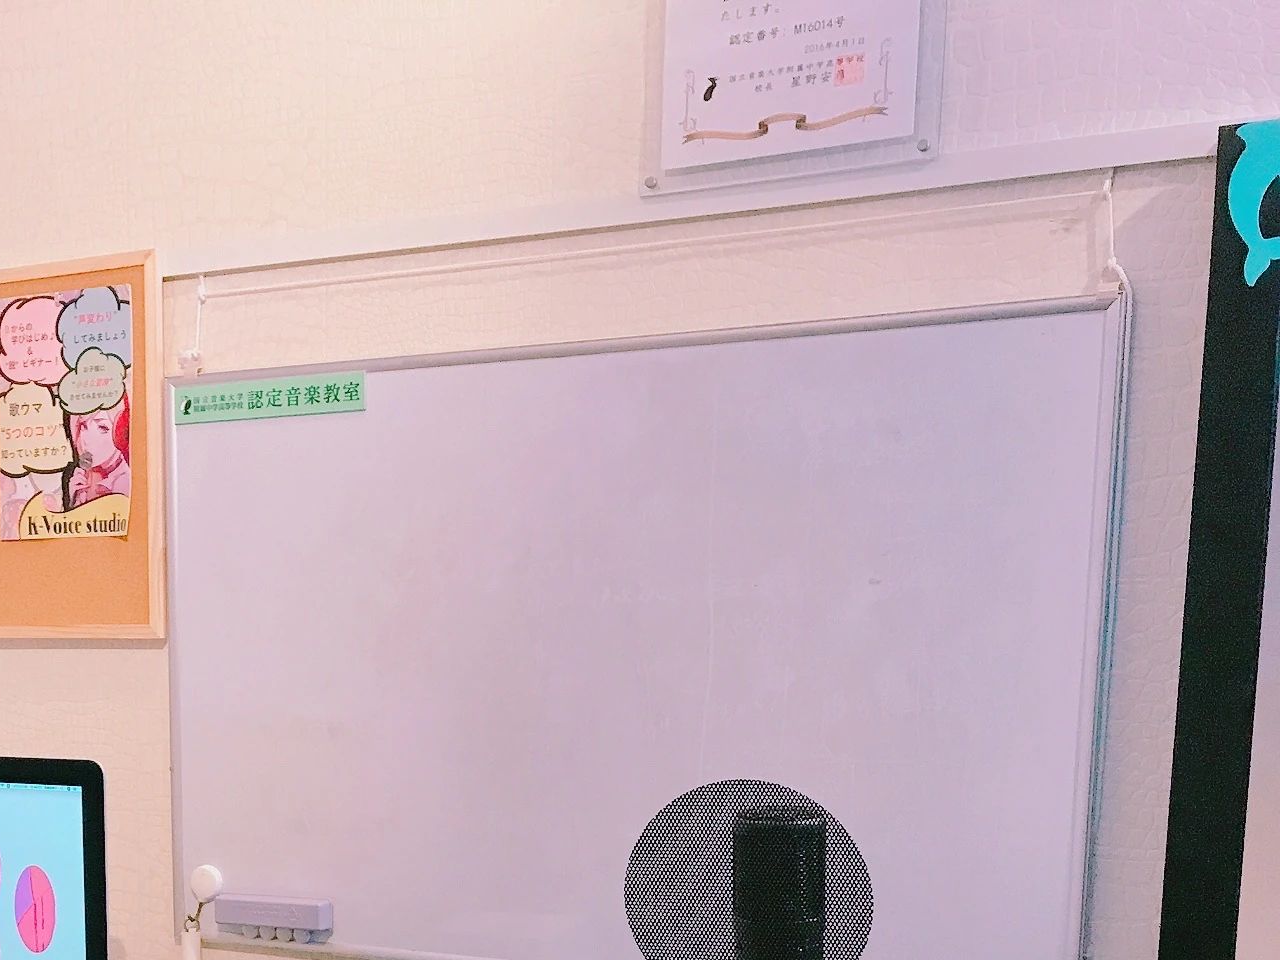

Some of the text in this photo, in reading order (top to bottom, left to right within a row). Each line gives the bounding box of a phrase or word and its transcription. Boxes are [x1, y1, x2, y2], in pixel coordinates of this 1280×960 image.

[73, 330, 126, 343] してみましょう
[247, 381, 361, 410] 認定音楽教室
[27, 513, 127, 536] K-Voice studio
